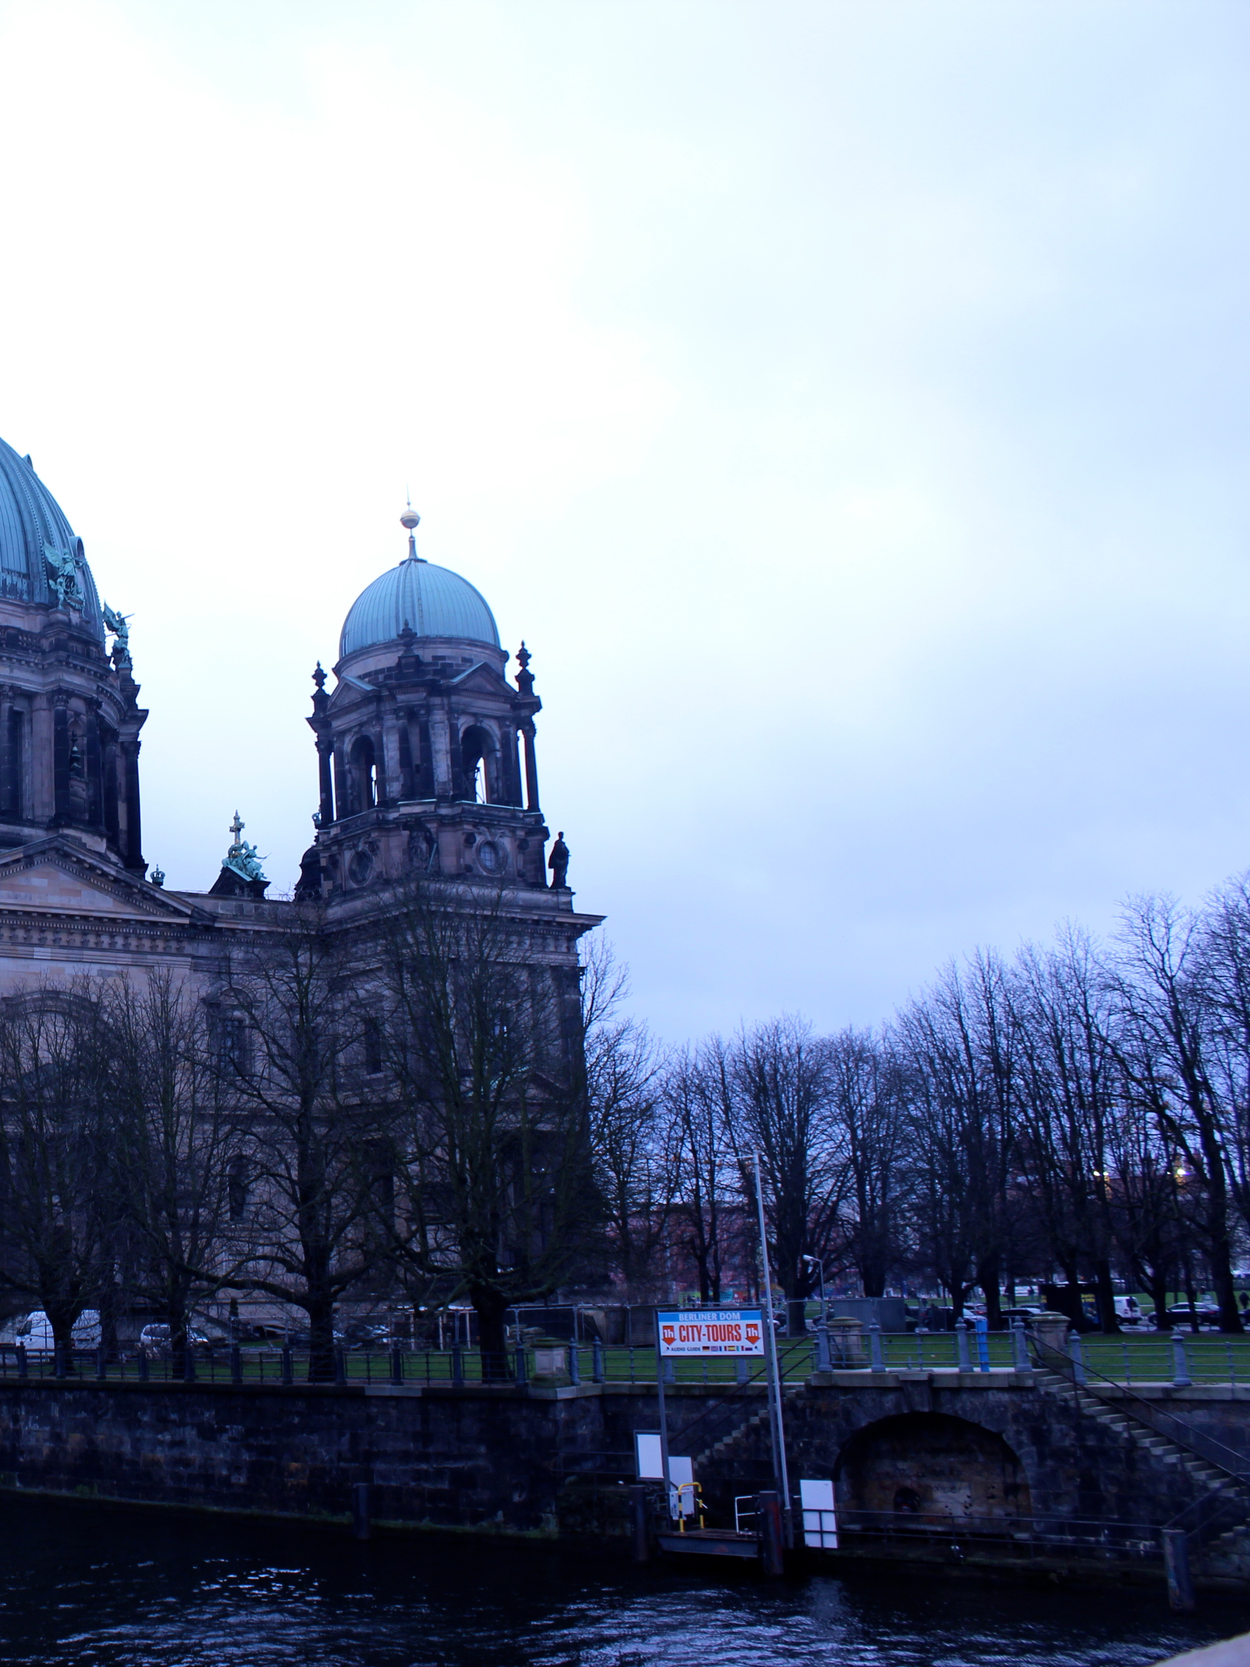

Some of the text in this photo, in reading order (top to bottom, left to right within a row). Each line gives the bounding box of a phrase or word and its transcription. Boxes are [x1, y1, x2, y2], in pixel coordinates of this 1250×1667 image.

[679, 1312, 741, 1321] BERLINER DOM
[663, 1328, 674, 1338] 1h
[679, 1324, 741, 1342] CITY-TOURS
[746, 1328, 758, 1337] 1h
